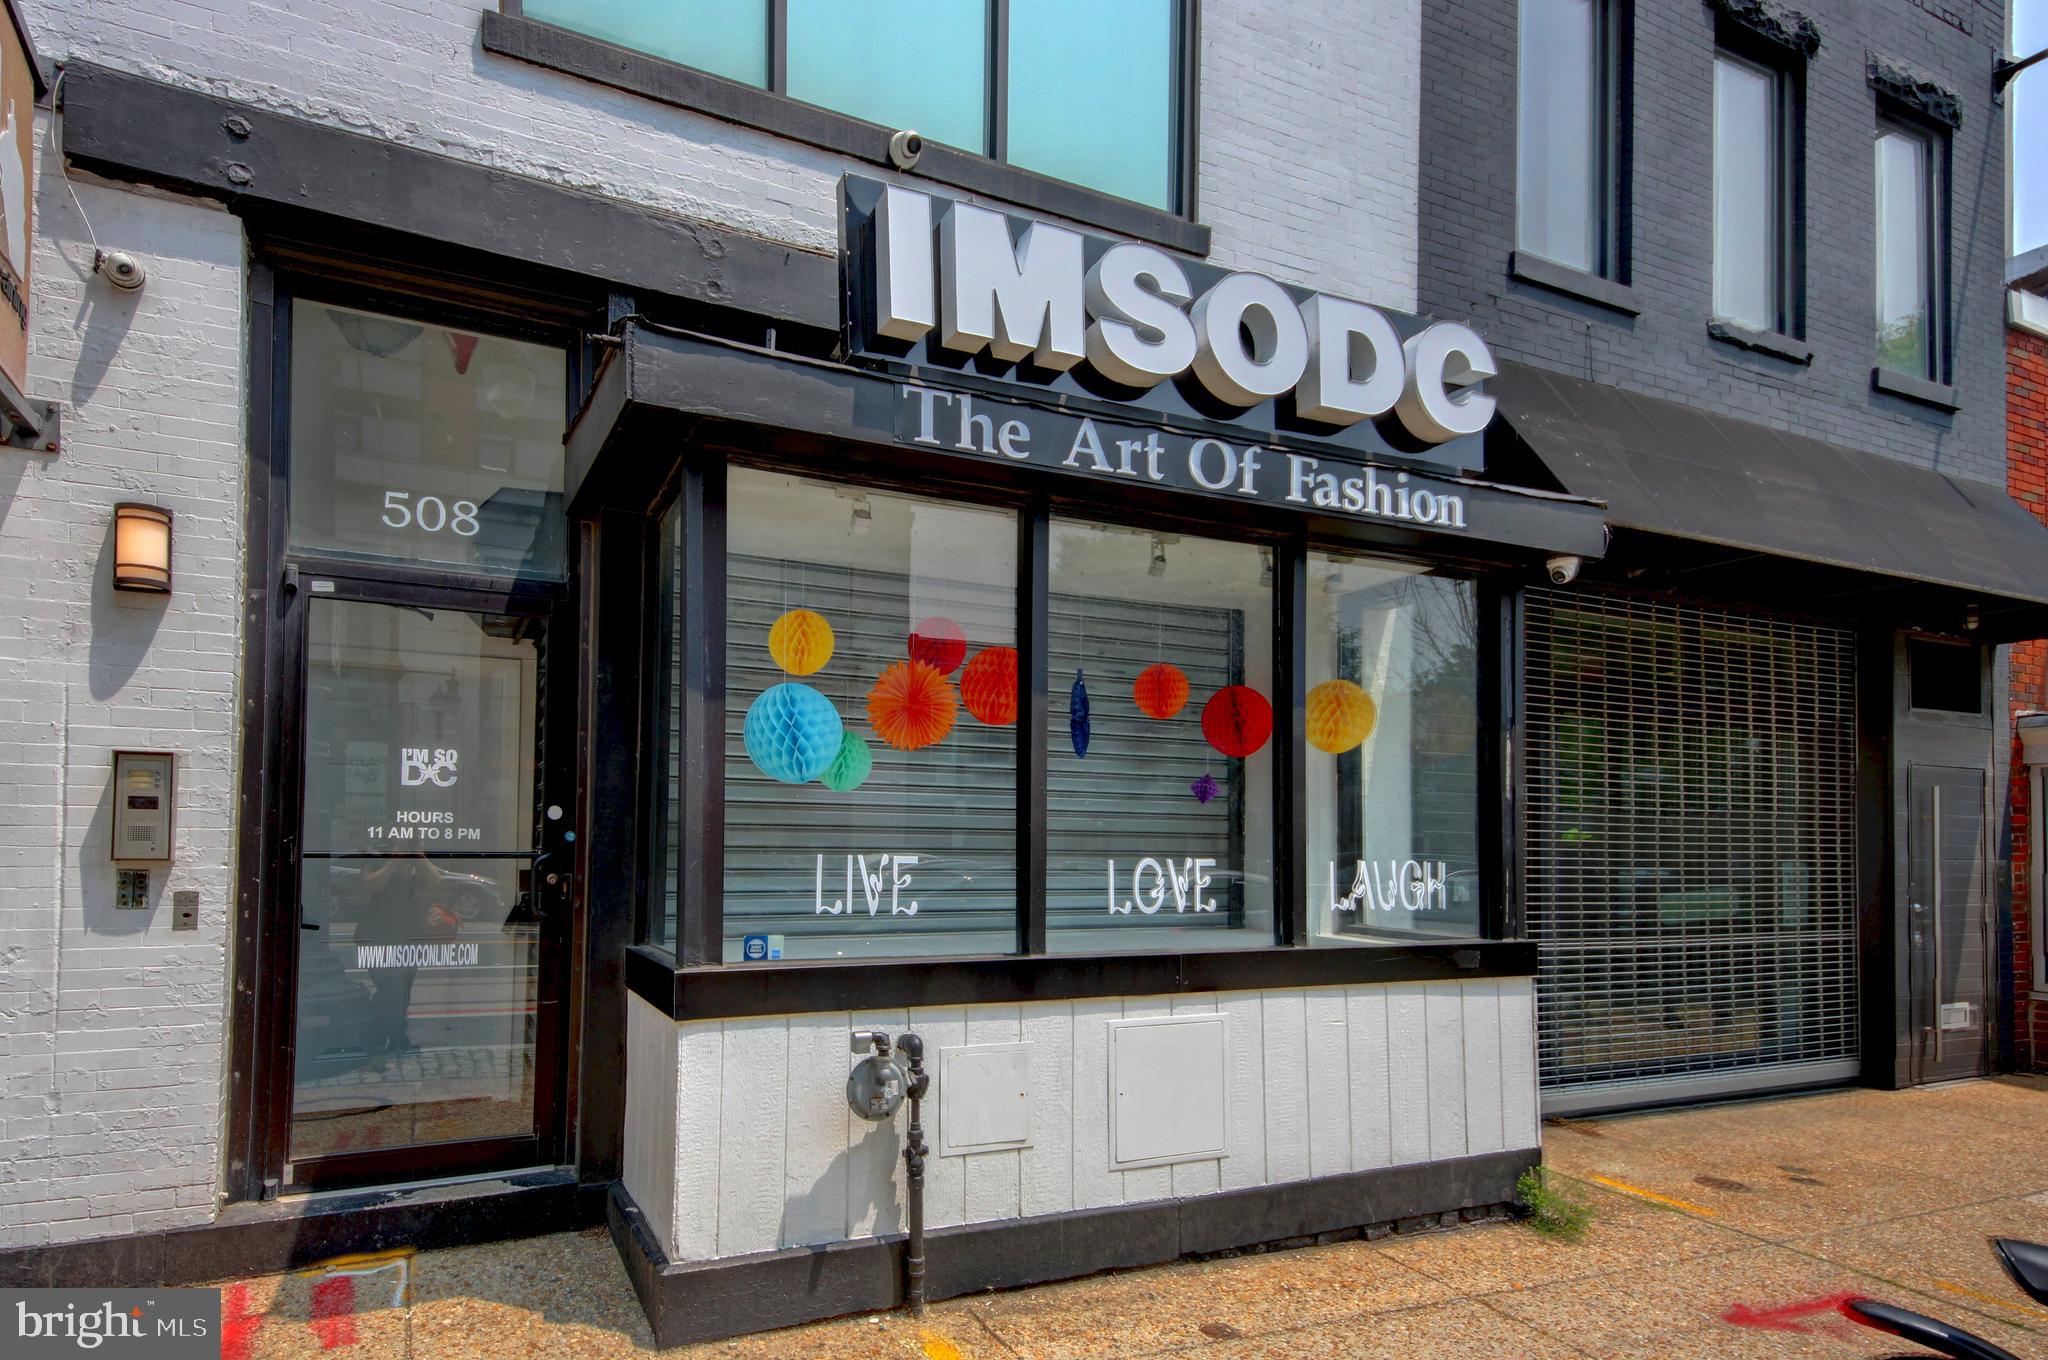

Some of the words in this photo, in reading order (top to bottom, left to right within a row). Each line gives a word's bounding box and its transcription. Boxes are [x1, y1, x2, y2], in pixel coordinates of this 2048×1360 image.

[877, 184, 1497, 442] IMSODC
[902, 383, 1031, 460] The
[1062, 418, 1165, 482] Art
[1188, 438, 1263, 495] Of
[1285, 453, 1467, 530] Fashion
[382, 490, 481, 537] 508
[401, 747, 429, 763] I'M
[434, 748, 458, 764] SO
[367, 826, 383, 839] 11
[387, 826, 414, 839] AM
[418, 827, 440, 839] TO
[444, 827, 453, 840] 8
[457, 828, 481, 840] PM
[396, 810, 454, 824] HOURS
[815, 853, 919, 917] LIVE
[1107, 857, 1218, 916] LOVE
[1328, 859, 1448, 913] LAUGH
[357, 943, 479, 969] WWW.IMSODCONLINE.COM
